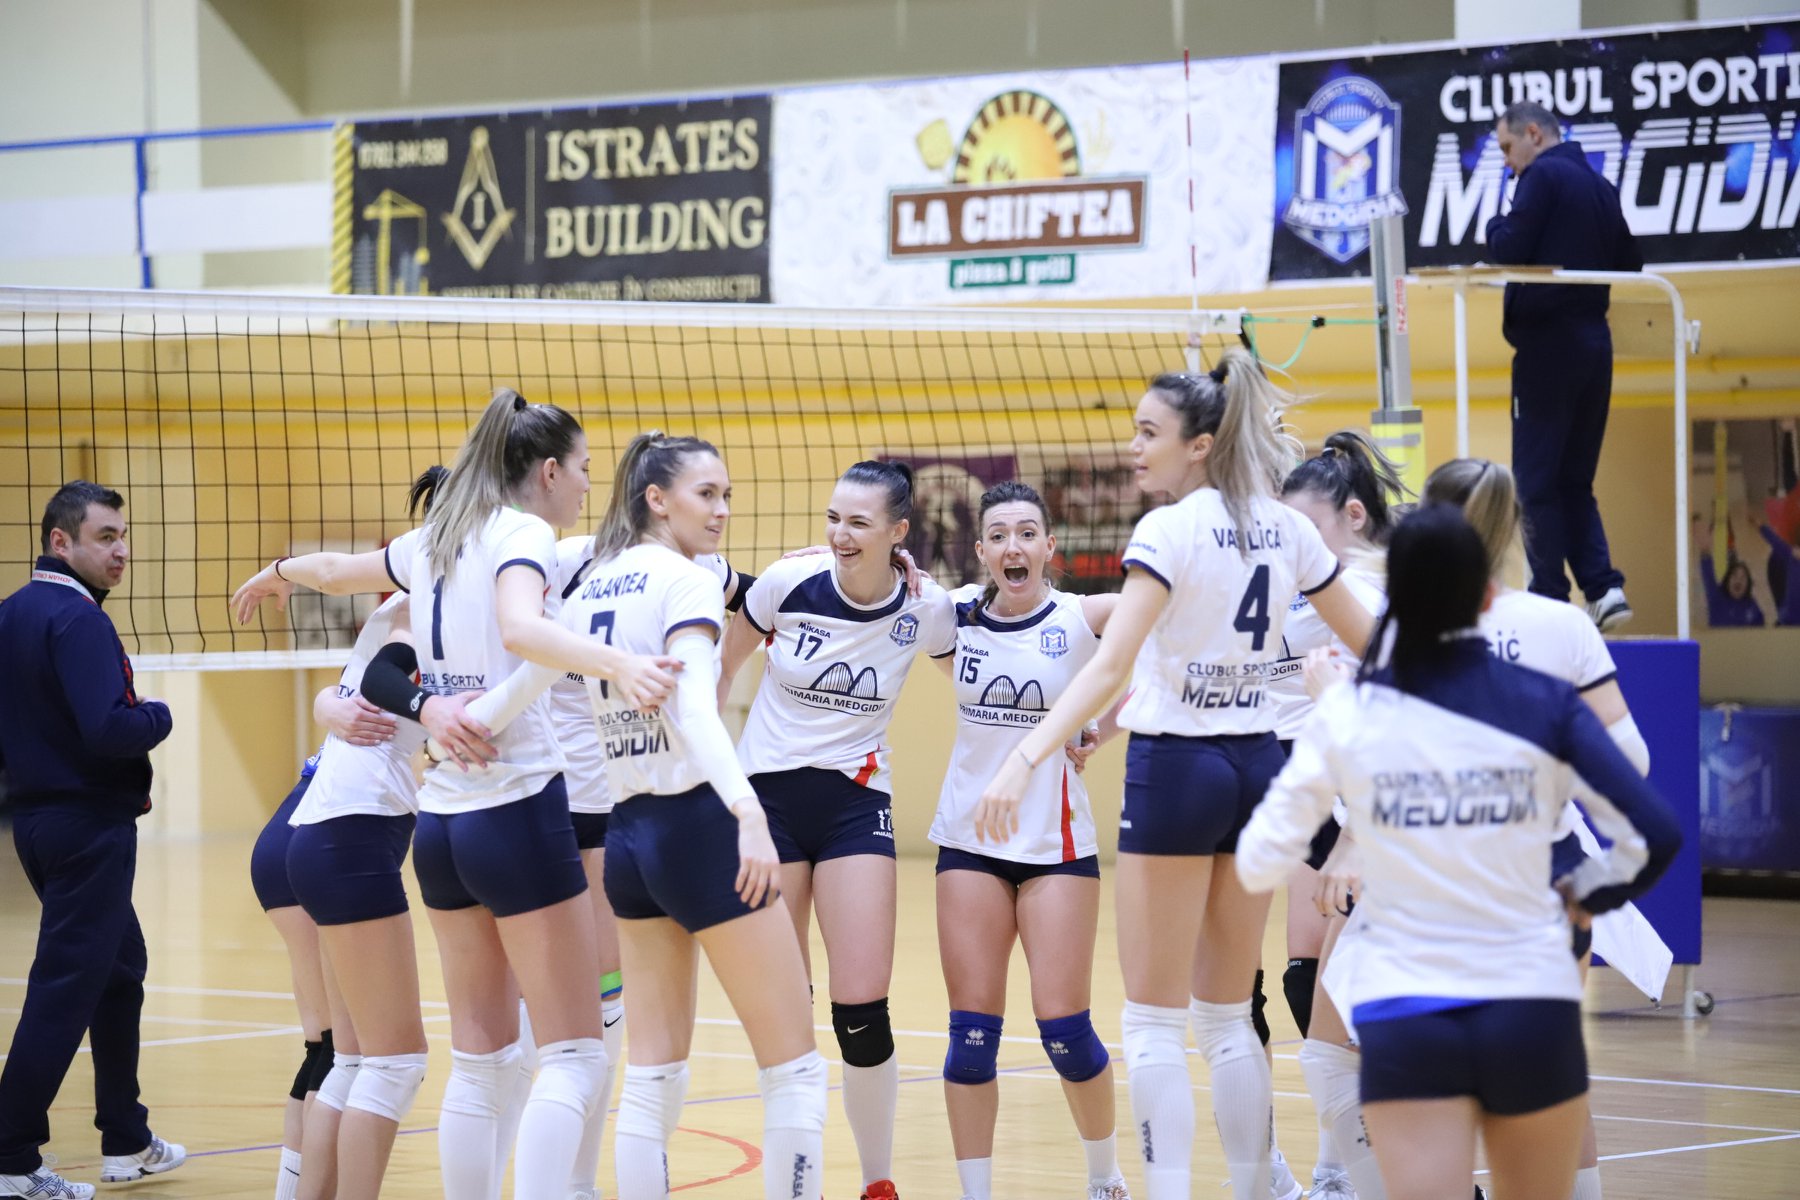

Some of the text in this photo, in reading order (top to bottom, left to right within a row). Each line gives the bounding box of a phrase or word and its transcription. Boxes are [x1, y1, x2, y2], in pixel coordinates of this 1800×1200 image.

[1440, 51, 1800, 123] CLUBUL SPORTI
[545, 118, 759, 182] ISTRATES
[545, 197, 766, 259] BUILDING
[897, 188, 1134, 247] LA CHIFTEA
[432, 574, 445, 661] 1
[1233, 564, 1270, 651] 4
[589, 610, 616, 700] 7
[793, 632, 823, 662] 17
[959, 655, 982, 685] 15
